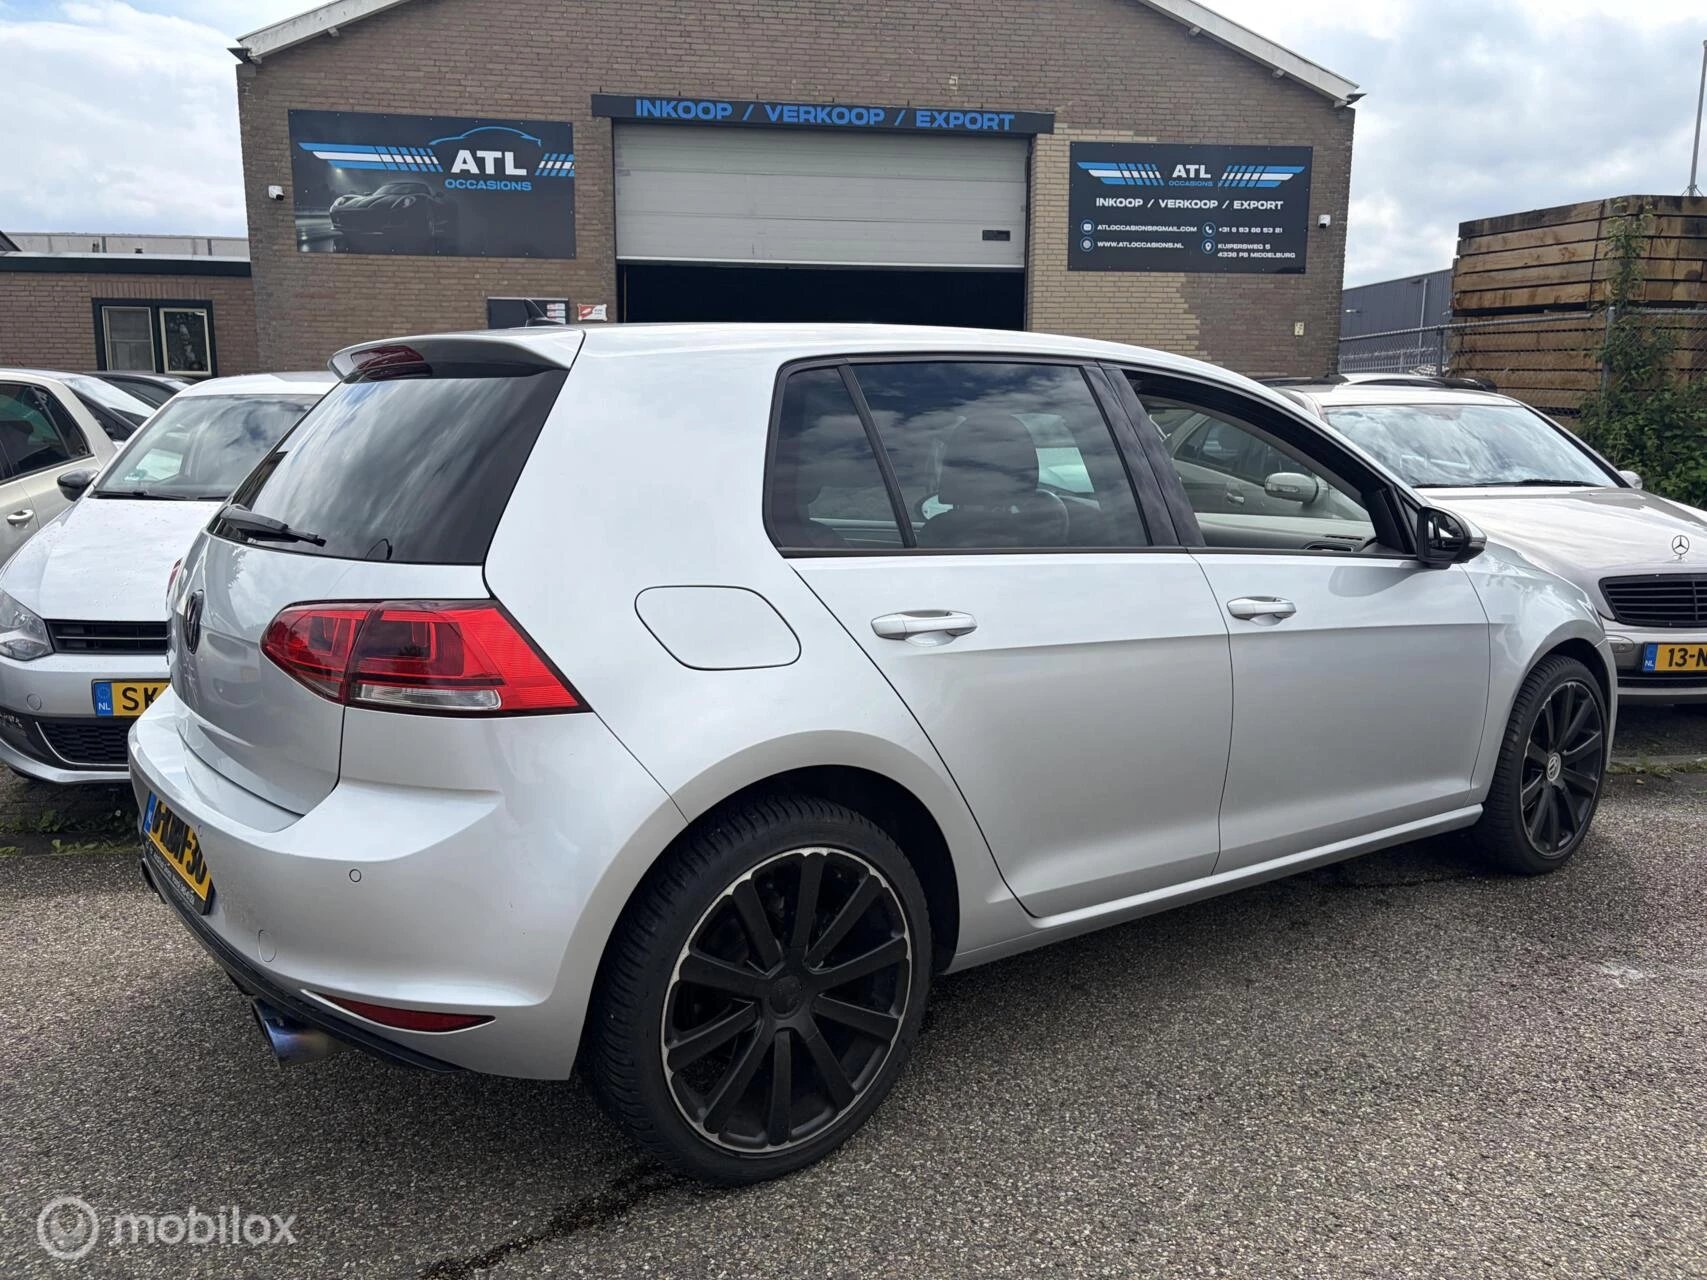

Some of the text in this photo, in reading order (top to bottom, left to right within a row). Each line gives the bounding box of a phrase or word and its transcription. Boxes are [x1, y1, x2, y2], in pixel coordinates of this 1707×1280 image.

[636, 99, 1015, 130] INKOOP / VERKOOP / EXPORT
[450, 149, 527, 176] ATL
[1172, 164, 1211, 178] ATL
[444, 179, 532, 191] OCCASIONS
[1096, 198, 1284, 209] INKOOP / VERKOOP / EXPORT
[98, 702, 111, 711] NL
